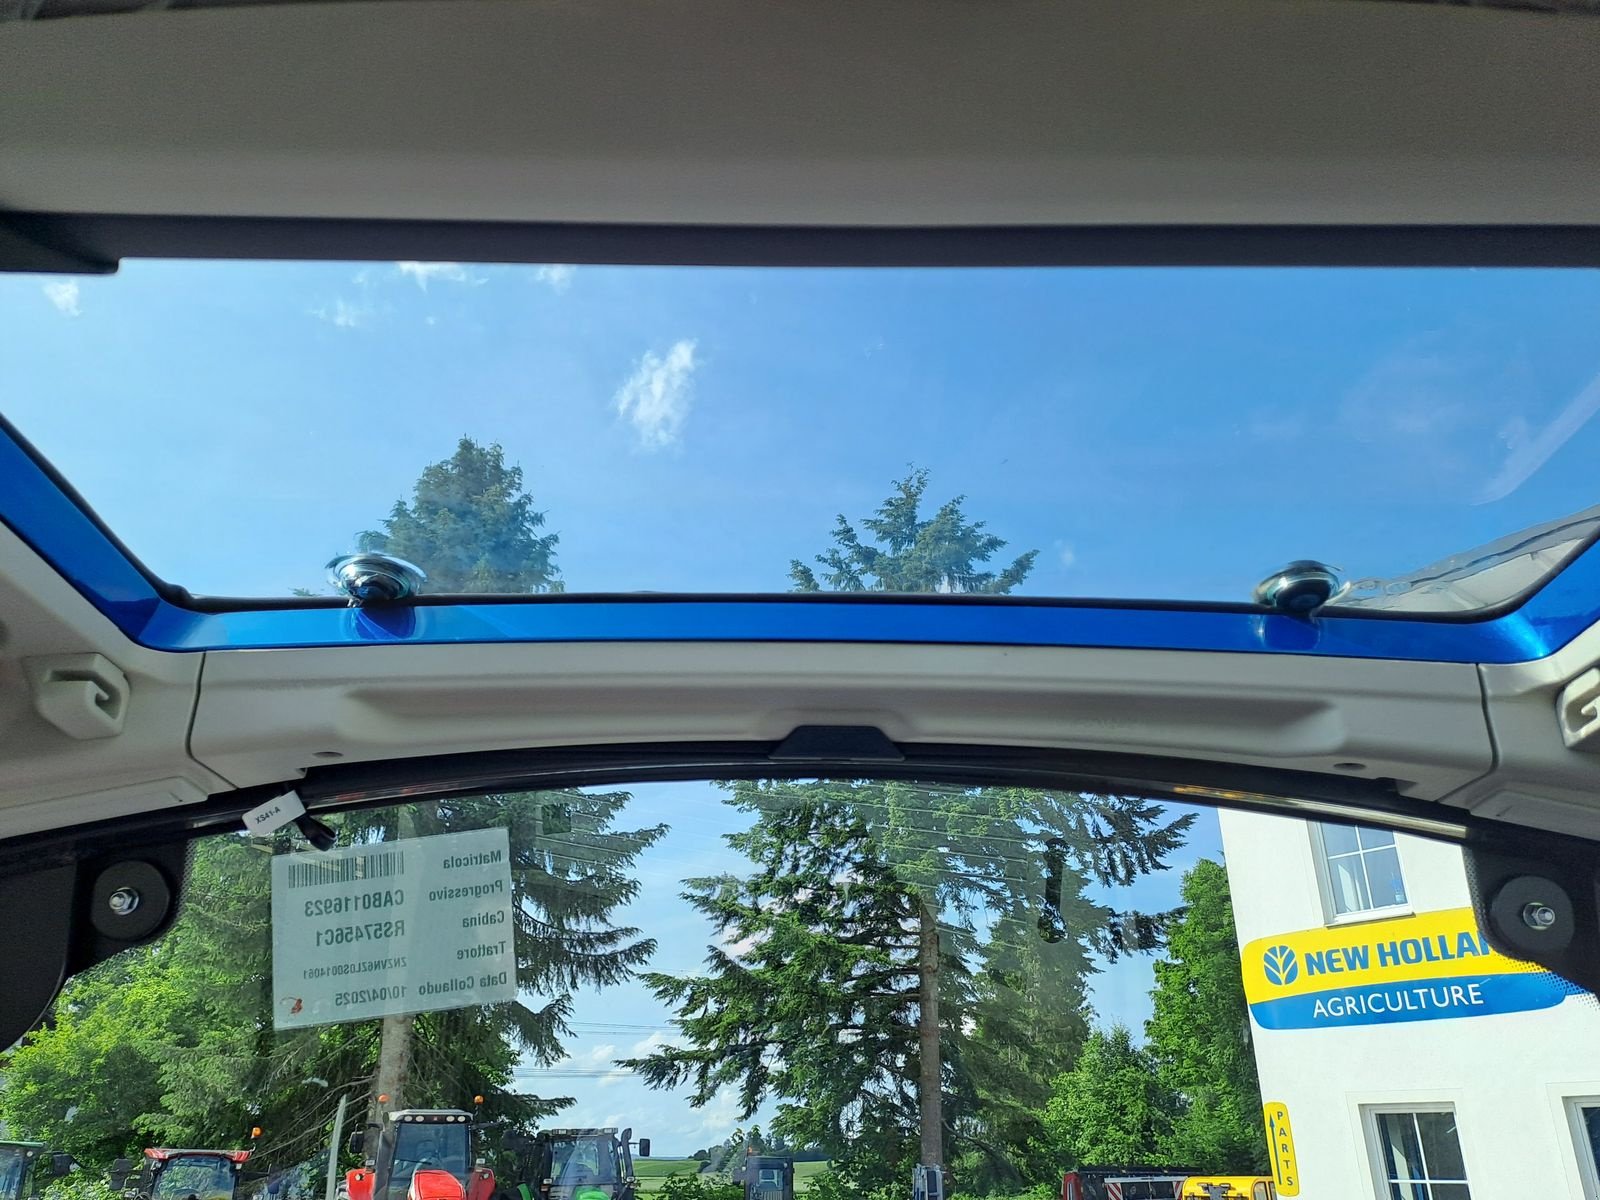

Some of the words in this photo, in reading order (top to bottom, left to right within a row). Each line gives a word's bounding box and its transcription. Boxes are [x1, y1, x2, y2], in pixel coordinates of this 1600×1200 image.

[255, 806, 281, 824] XS41-A
[1305, 944, 1369, 976] NEW
[1313, 983, 1484, 1018] AGRICULTURE
[1277, 1111, 1293, 1186] PARTS
